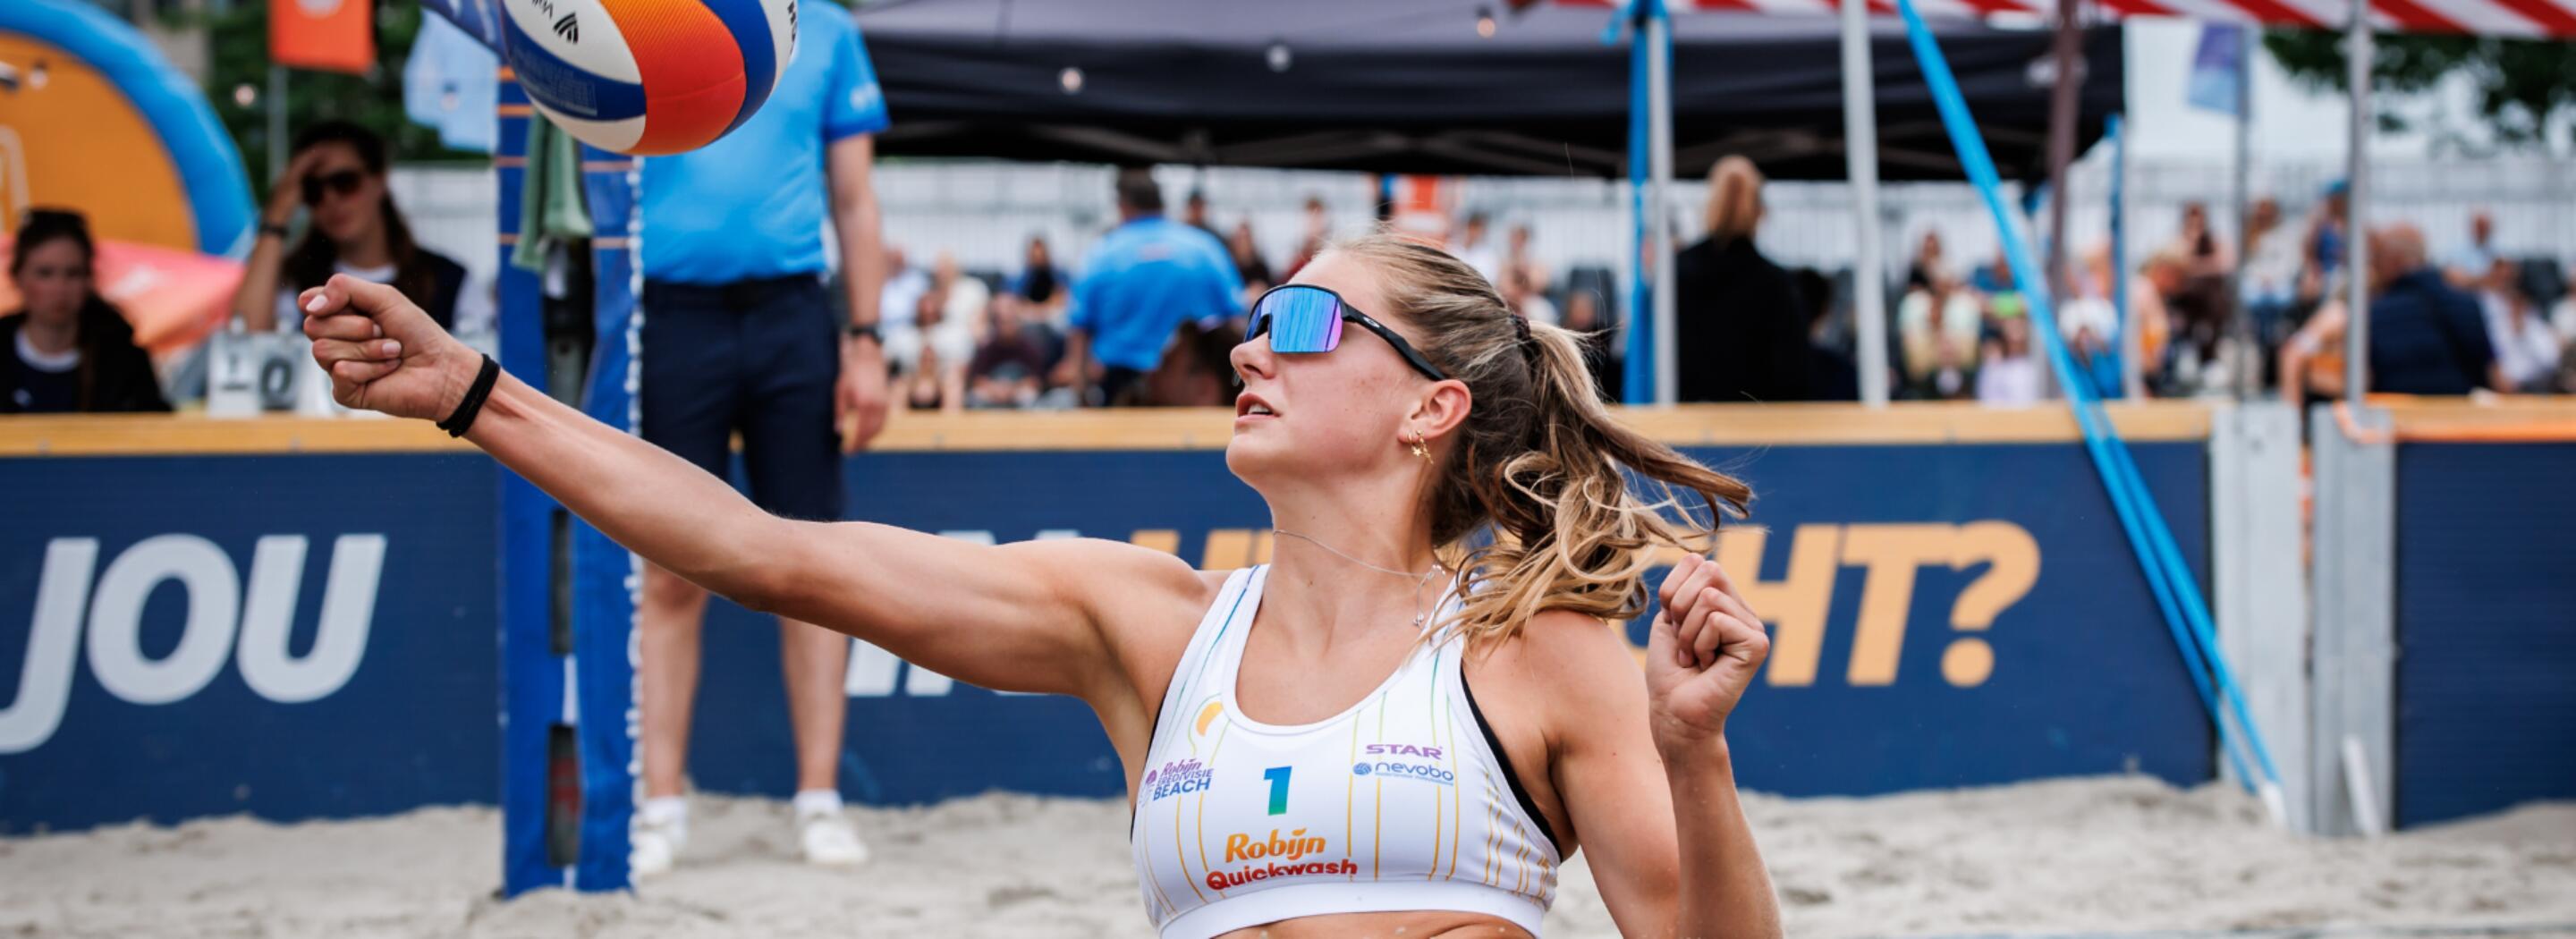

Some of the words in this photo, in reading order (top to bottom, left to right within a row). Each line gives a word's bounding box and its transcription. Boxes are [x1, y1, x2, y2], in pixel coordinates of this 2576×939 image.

[0, 533, 387, 755] JOU
[1366, 744, 1442, 760] STAR
[1375, 762, 1453, 781] nevobo
[1153, 778, 1211, 801] BEACH
[1264, 766, 1292, 816] 1
[1225, 828, 1326, 863] Robijn
[1207, 859, 1358, 891] Quickwash
